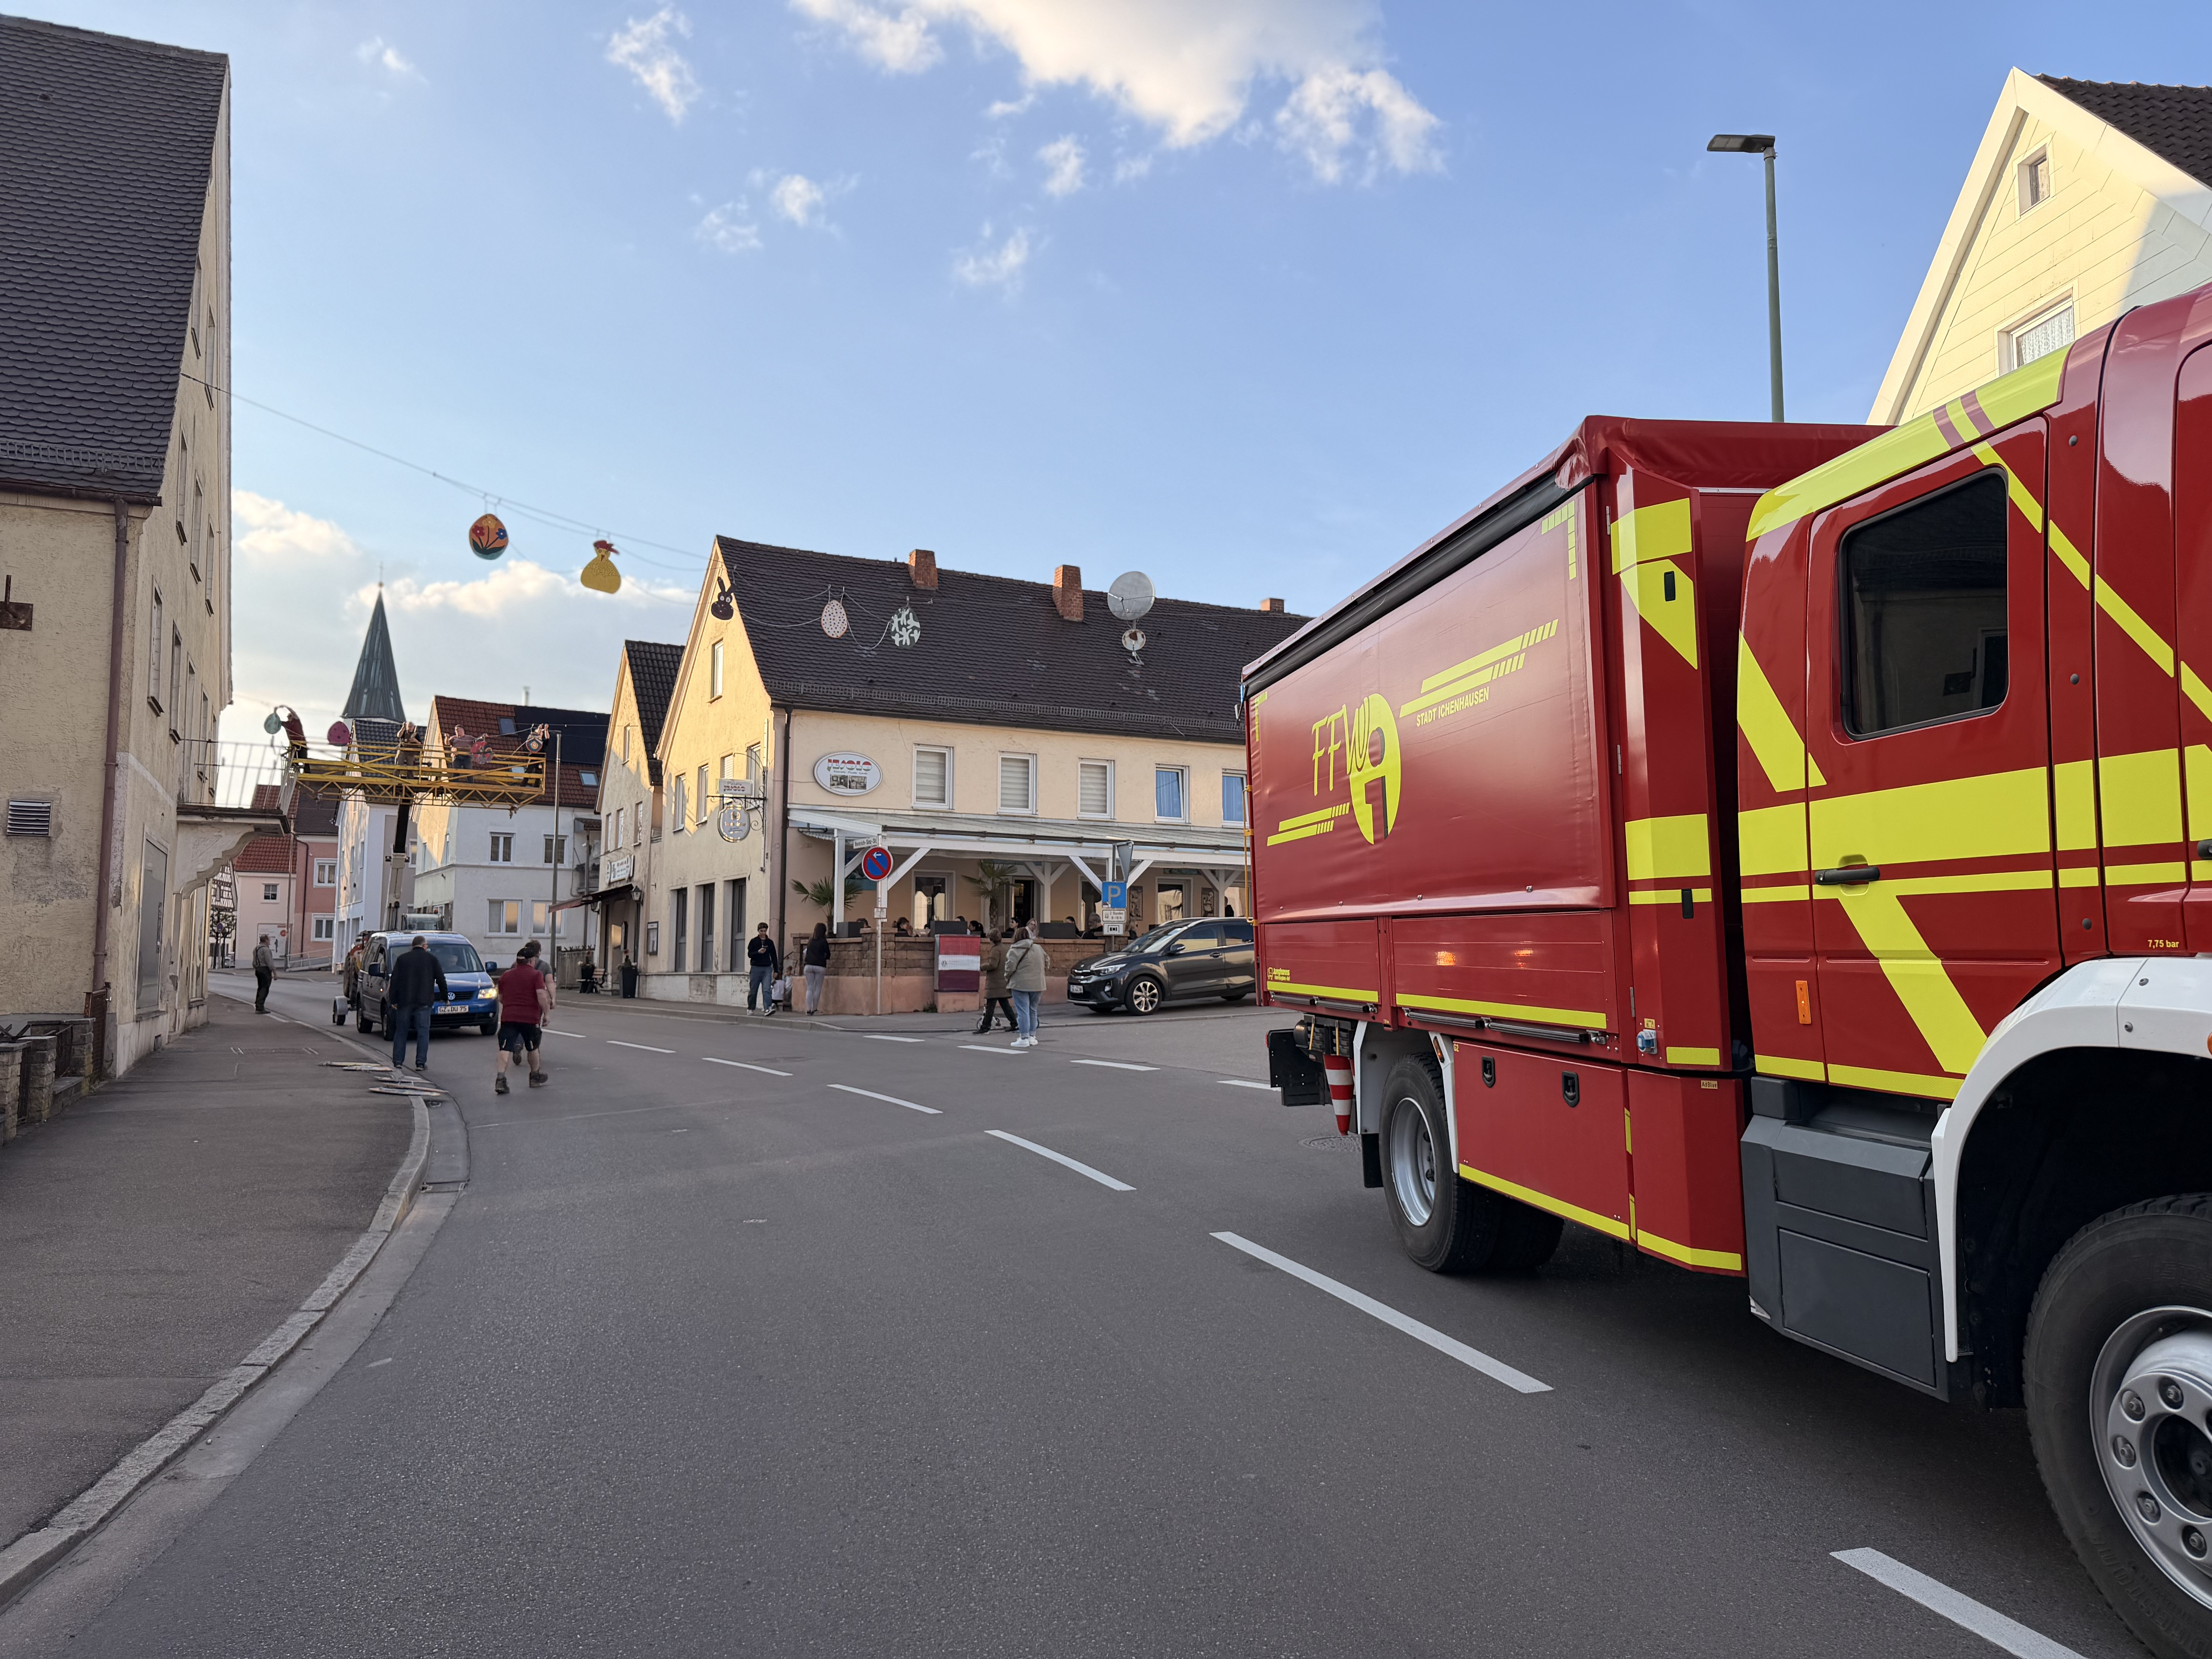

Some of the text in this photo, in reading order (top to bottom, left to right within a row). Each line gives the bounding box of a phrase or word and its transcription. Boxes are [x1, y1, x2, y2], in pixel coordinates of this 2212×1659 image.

[1417, 686, 1489, 727] STADT ICHENHAUSEN
[1108, 885, 1121, 905] P
[2147, 939, 2179, 949] 7,75 bar
[1453, 1043, 1459, 1052] G2
